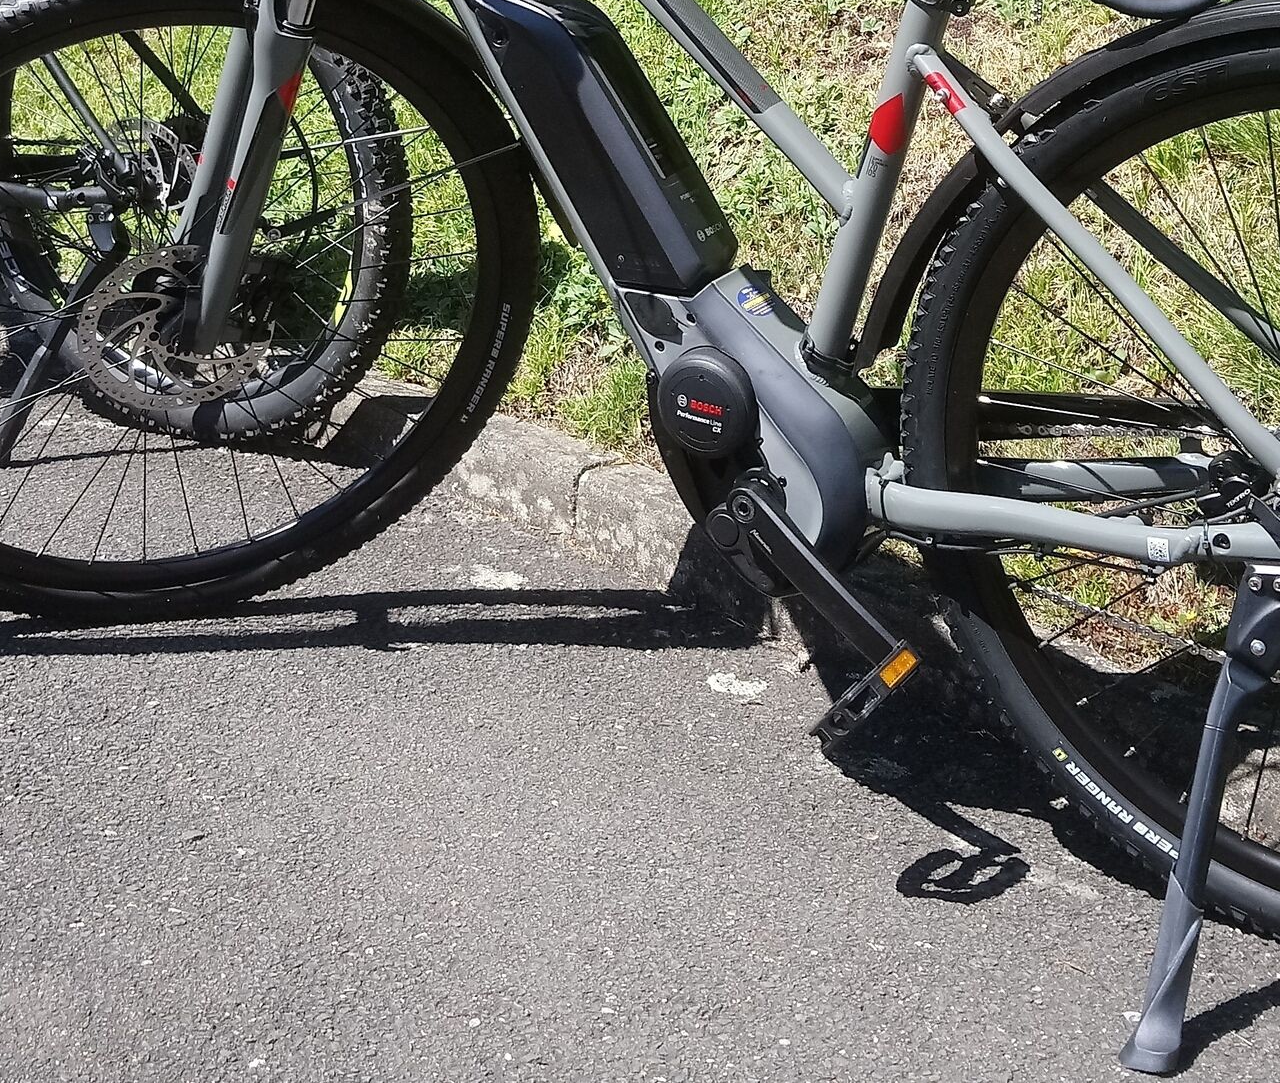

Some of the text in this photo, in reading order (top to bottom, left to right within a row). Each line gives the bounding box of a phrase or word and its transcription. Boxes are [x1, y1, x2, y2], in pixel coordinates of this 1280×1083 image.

[466, 302, 512, 413] SUPERB RANGER
[690, 398, 723, 416] BOSCH
[710, 419, 723, 428] Line
[712, 426, 722, 434] CX
[1065, 760, 1135, 825] RANGER
